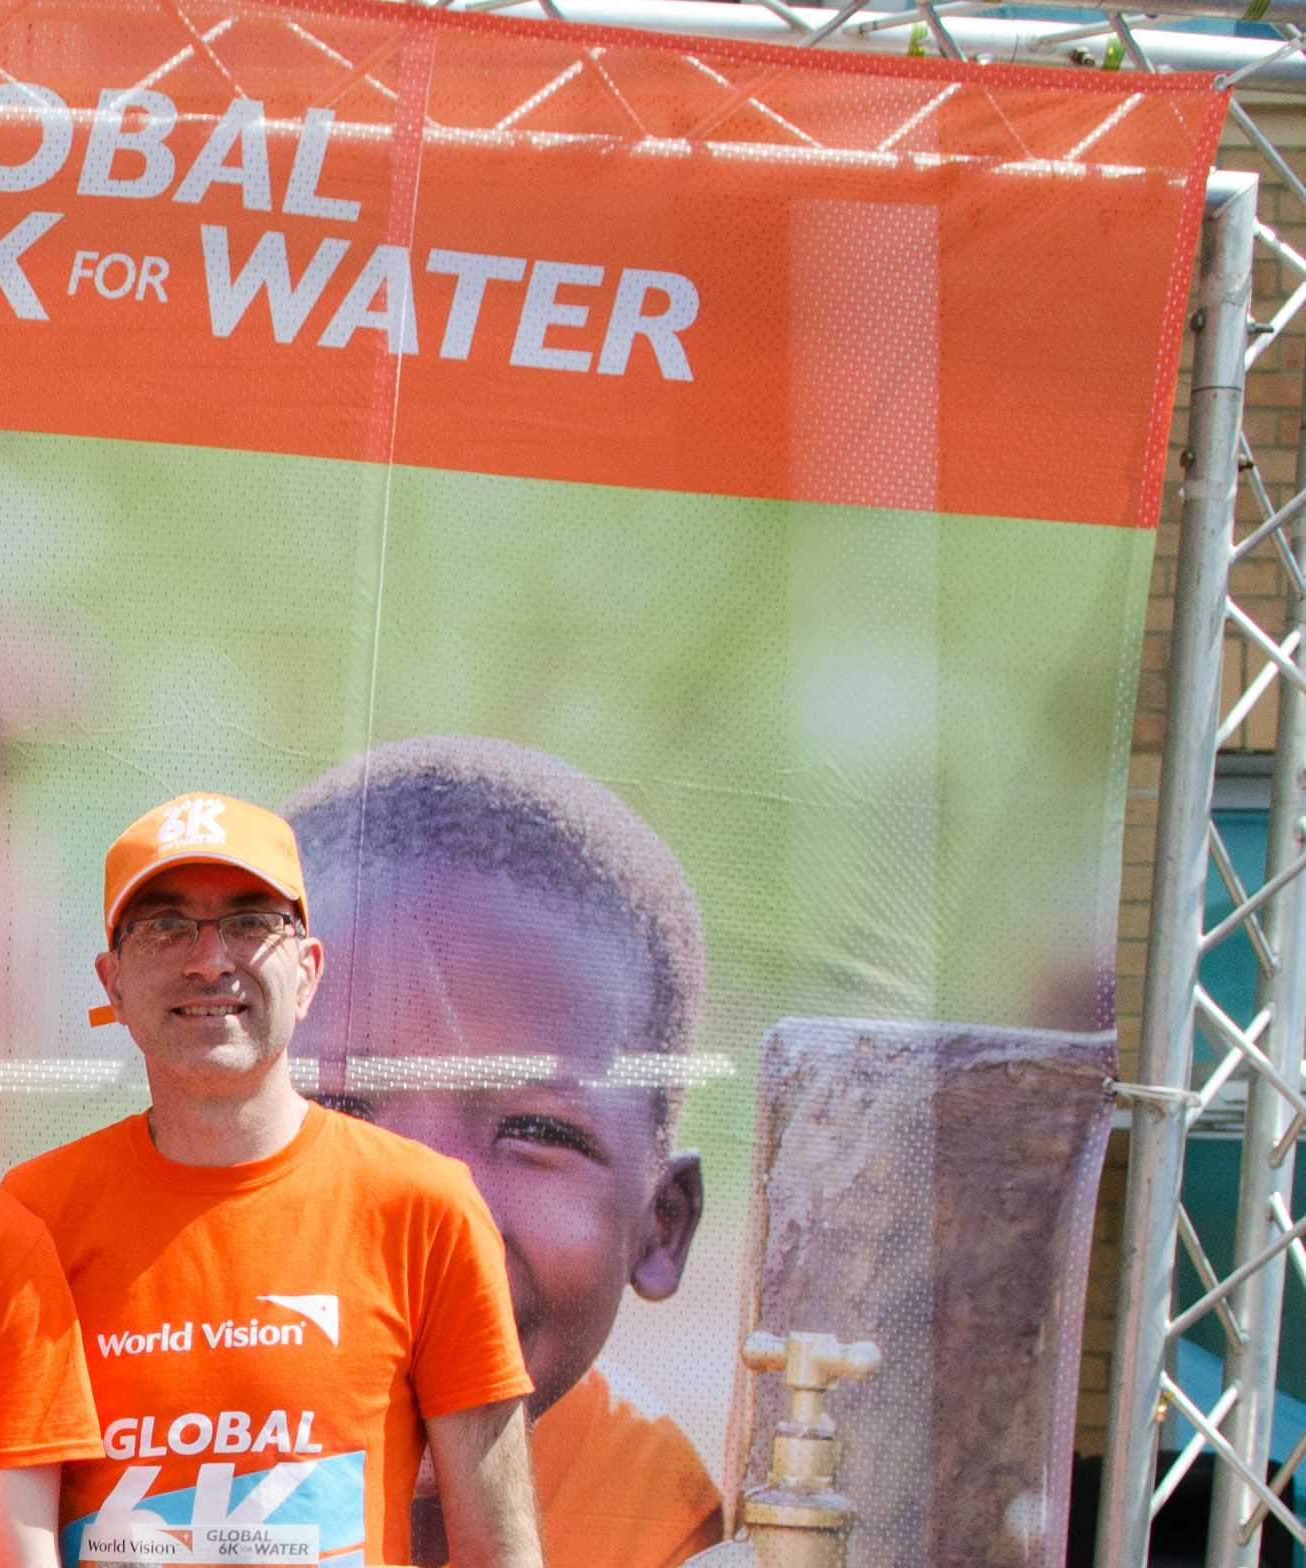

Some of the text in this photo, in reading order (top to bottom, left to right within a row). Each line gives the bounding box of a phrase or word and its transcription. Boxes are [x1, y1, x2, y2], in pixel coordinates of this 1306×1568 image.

[68, 249, 170, 304] FOR
[200, 224, 699, 382] WATER
[97, 1320, 193, 1359] World
[103, 1409, 324, 1461] GLOBAL
[86, 1537, 177, 1555] World Vision
[206, 1529, 272, 1542] GLOBAL
[218, 1543, 239, 1555] 6K
[254, 1543, 309, 1556] WATER
